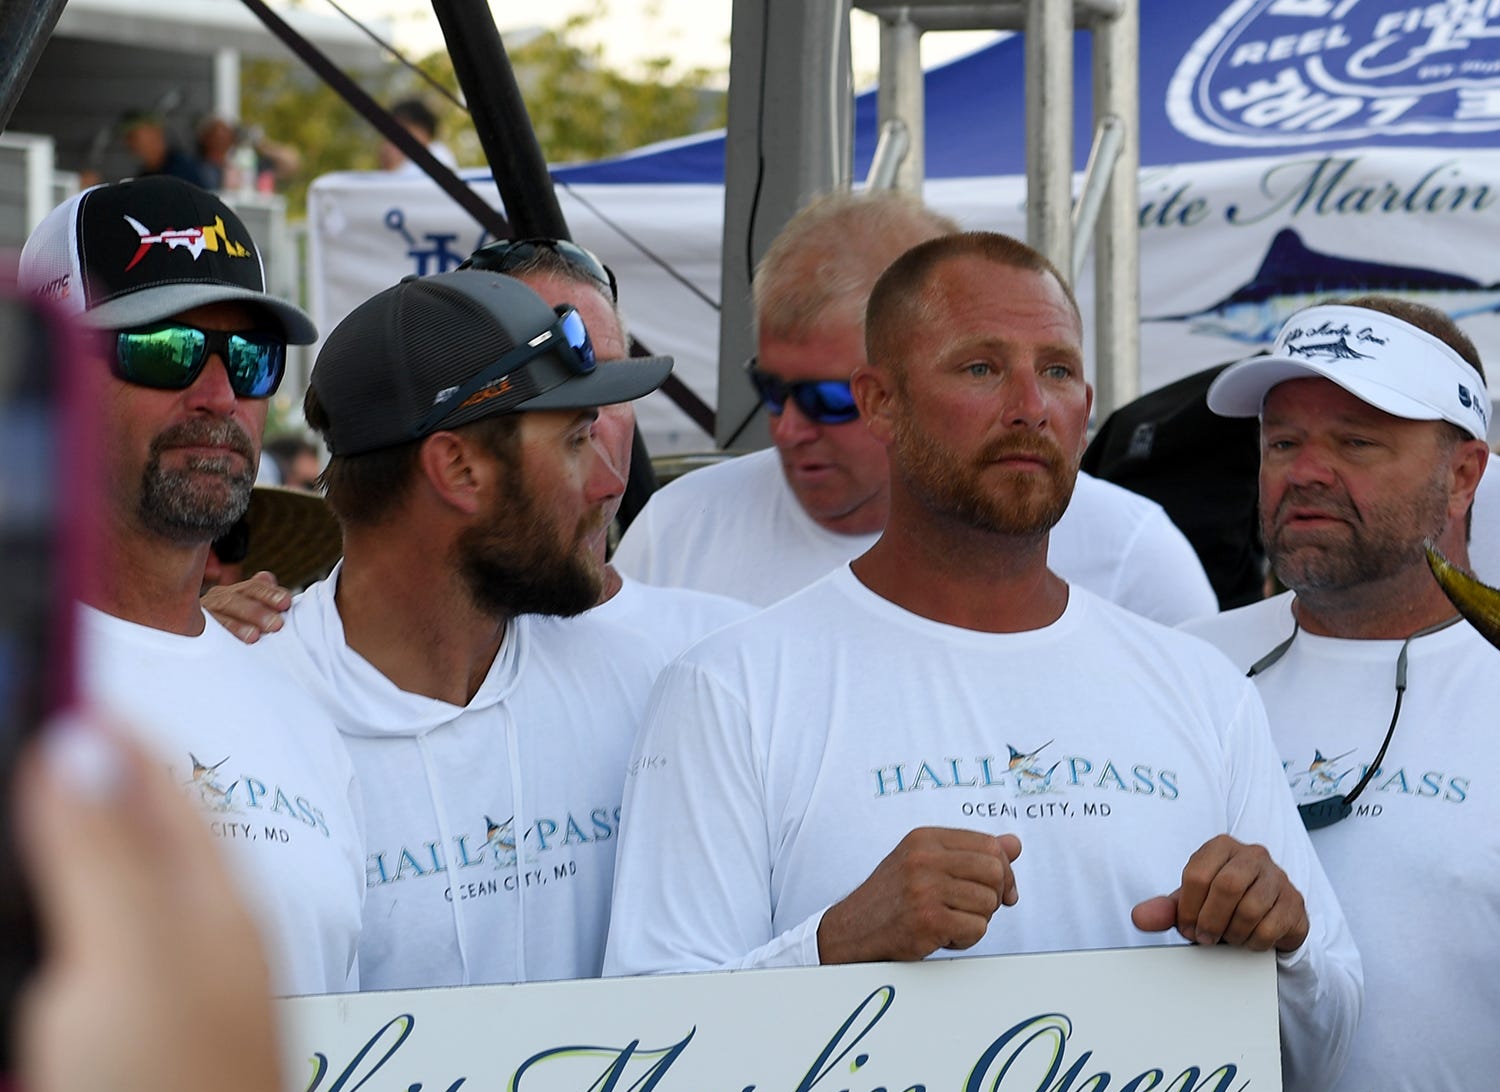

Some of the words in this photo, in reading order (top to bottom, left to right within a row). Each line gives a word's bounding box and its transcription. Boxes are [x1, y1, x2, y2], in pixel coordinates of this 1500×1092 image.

[1229, 24, 1351, 67] REEL
[1225, 154, 1492, 227] Marlin
[872, 755, 1006, 798] HALL
[1062, 754, 1179, 801] PASS
[962, 802, 1017, 819] OCEAN
[1025, 803, 1076, 820] CITY,
[1082, 803, 1112, 818] MD
[1356, 804, 1383, 817] MD
[265, 826, 290, 843] MD
[366, 834, 486, 888] HALL
[553, 860, 577, 882] MD
